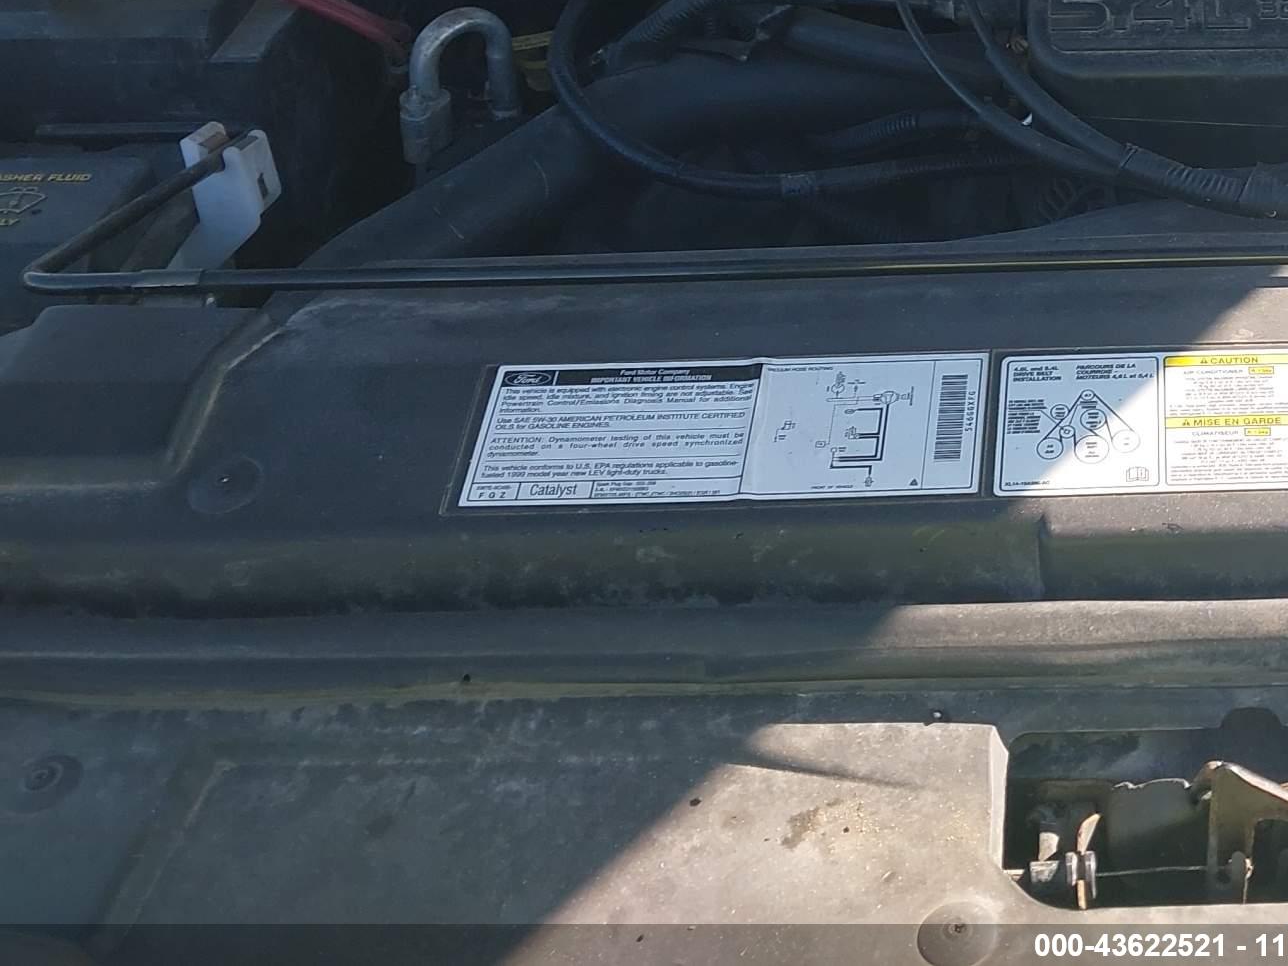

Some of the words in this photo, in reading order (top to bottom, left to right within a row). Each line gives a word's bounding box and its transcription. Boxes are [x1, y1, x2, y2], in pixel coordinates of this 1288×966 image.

[47, 173, 93, 182] FLUID
[1194, 418, 1221, 426] MISE
[1224, 418, 1239, 426] EN
[1243, 417, 1281, 425] GARDE
[684, 439, 743, 448] synchronized
[529, 483, 578, 499] Catalyst
